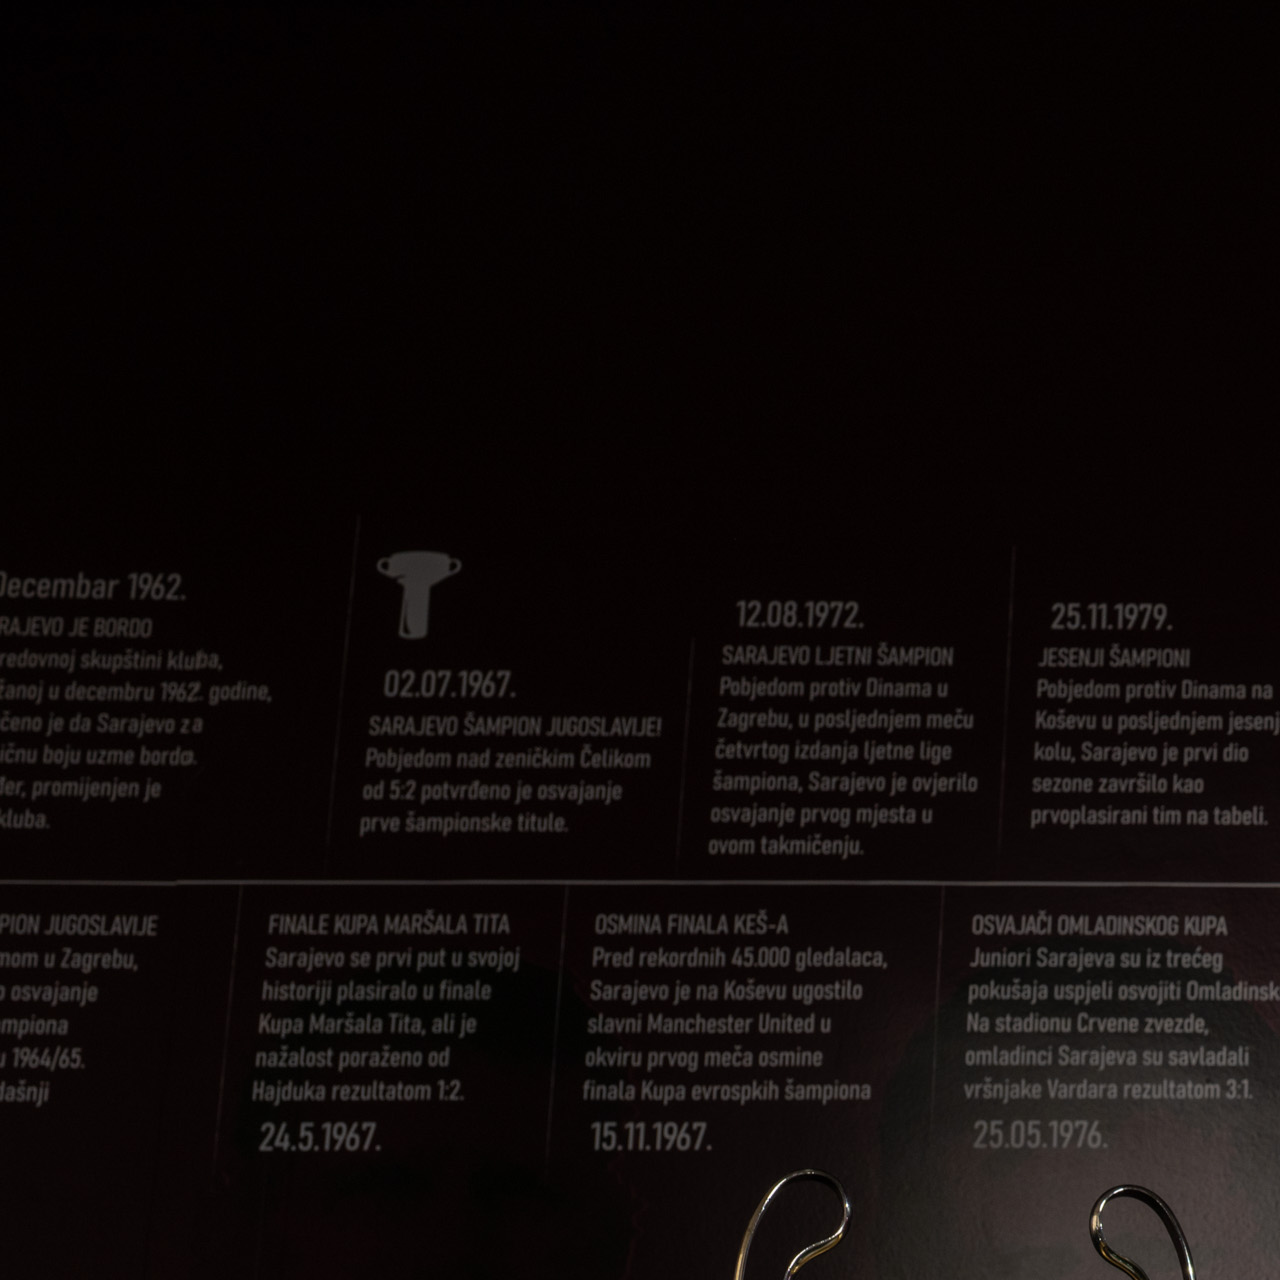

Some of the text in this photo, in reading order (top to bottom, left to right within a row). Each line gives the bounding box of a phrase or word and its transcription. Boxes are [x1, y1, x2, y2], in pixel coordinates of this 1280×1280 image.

[128, 572, 187, 601] 1962.
[68, 616, 89, 638] JE
[93, 616, 153, 639] BORDO
[736, 599, 865, 629] 12.08.1972.
[1050, 602, 1173, 631] 25.11.1979.
[722, 641, 954, 667] SARAJEVO LJETNI ŠAMPION
[1038, 643, 1191, 668] JESENJI ŠAMPIONI
[383, 669, 517, 699] 02.07.1967.
[368, 711, 663, 738] SARAJEVO ŠAMPION JUGOSLAVIJE!
[364, 743, 652, 773] Pobjedom nad zeničkim Čelikom
[359, 810, 569, 838] prve šampionske titule.
[1030, 804, 1269, 830] prvoplasirani tim na tabeli.
[708, 833, 864, 860] ovom takmičenju.
[44, 913, 159, 937] JUGOSLAVIJE
[268, 909, 511, 936] FINALE KUPA MARŠALA TITA
[594, 913, 662, 935] OSMINA
[667, 913, 729, 935] FINALA
[971, 909, 1229, 937] OSVAJAČI OMLADINSKOG KUPA
[592, 946, 888, 973] Pred rekordnih 45.000 gledalaca,
[251, 1079, 465, 1107] Hajduka rezultatom 1:2.
[258, 1121, 382, 1152] 24.5.1967.
[591, 1121, 713, 1152] 15.11.1967.
[972, 1119, 1109, 1150] 25.05.1976.
